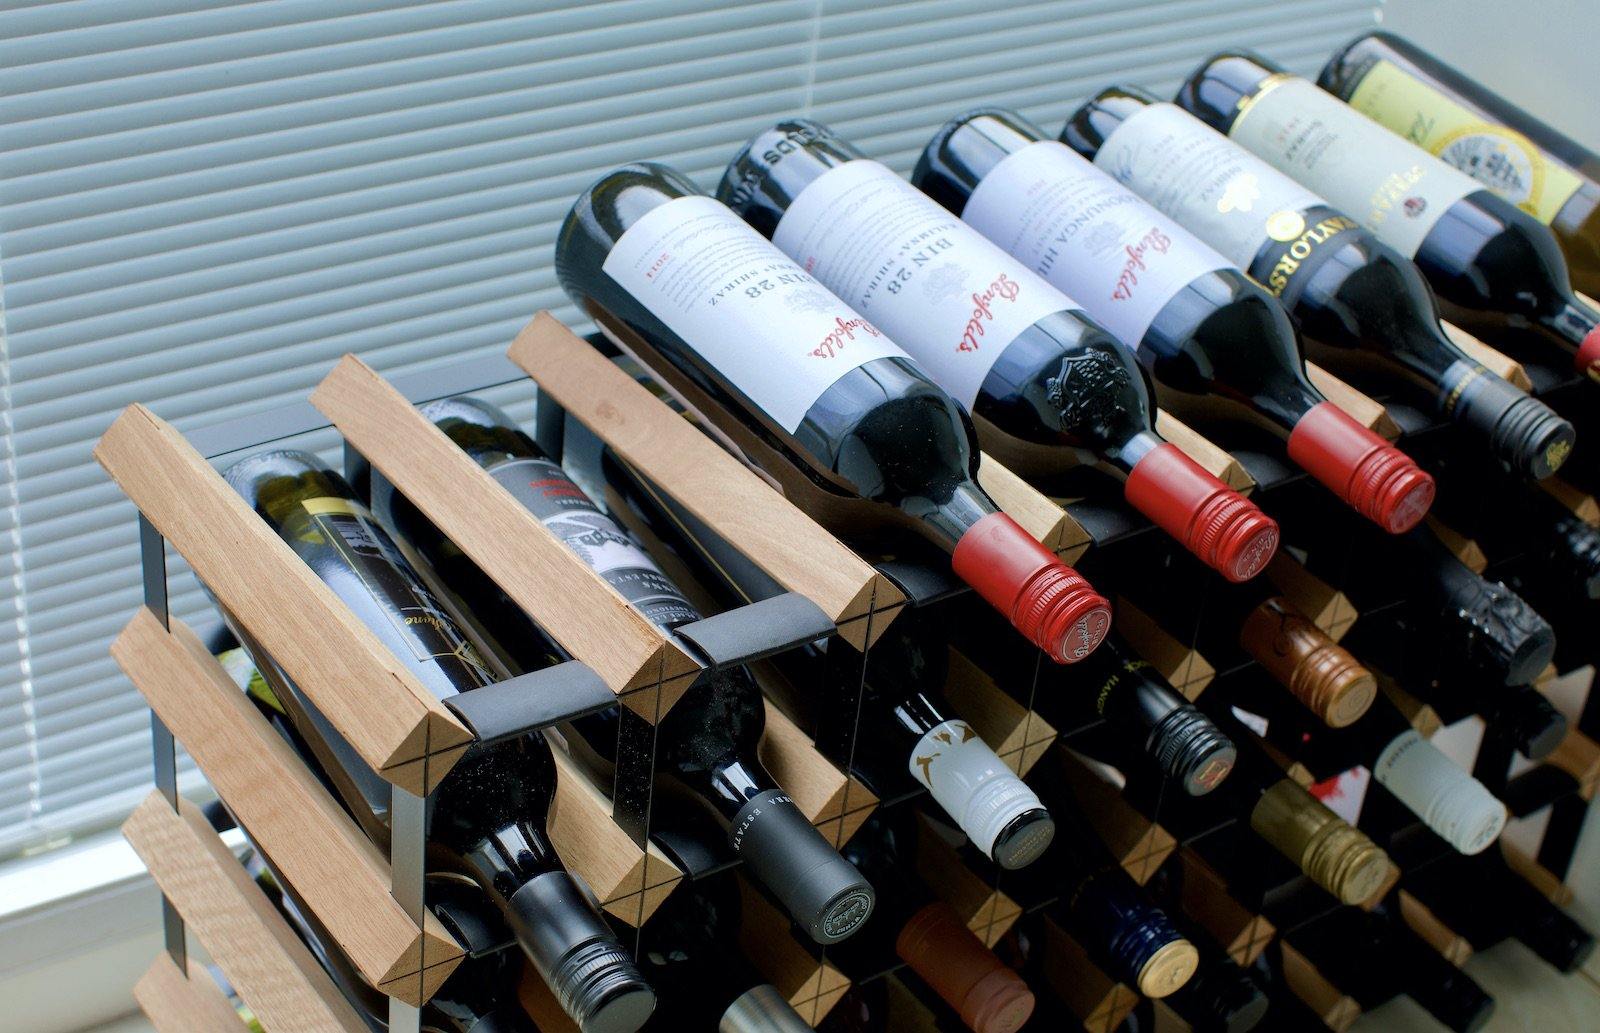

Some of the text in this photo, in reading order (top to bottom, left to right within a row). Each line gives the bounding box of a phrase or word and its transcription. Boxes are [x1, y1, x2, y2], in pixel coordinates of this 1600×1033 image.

[645, 251, 671, 279] 2014
[886, 237, 955, 295] BIN 28
[708, 269, 760, 307] SHIRAZ
[744, 278, 776, 299] 28
[956, 272, 1020, 352] Penfolds
[733, 807, 764, 851] ESTATE
